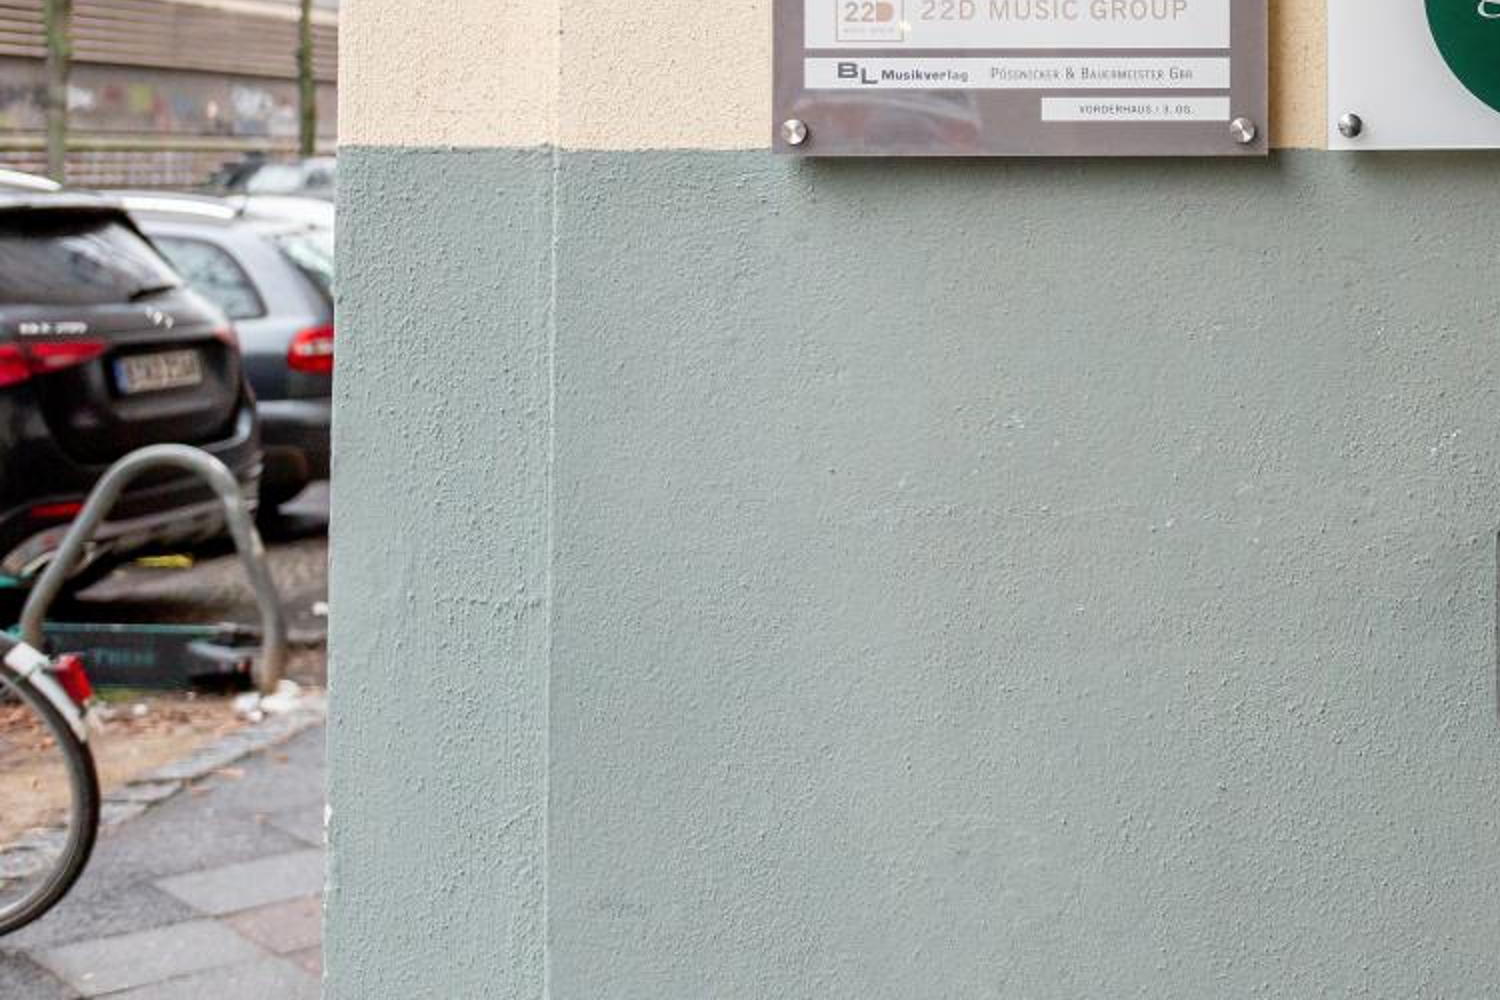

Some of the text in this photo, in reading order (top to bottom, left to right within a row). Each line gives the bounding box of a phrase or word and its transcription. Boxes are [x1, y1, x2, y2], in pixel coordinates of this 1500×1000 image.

[837, 62, 878, 84] BL
[881, 67, 969, 83] Musikverlag
[1065, 67, 1075, 80] &
[1079, 103, 1153, 115] VORDERHAUS
